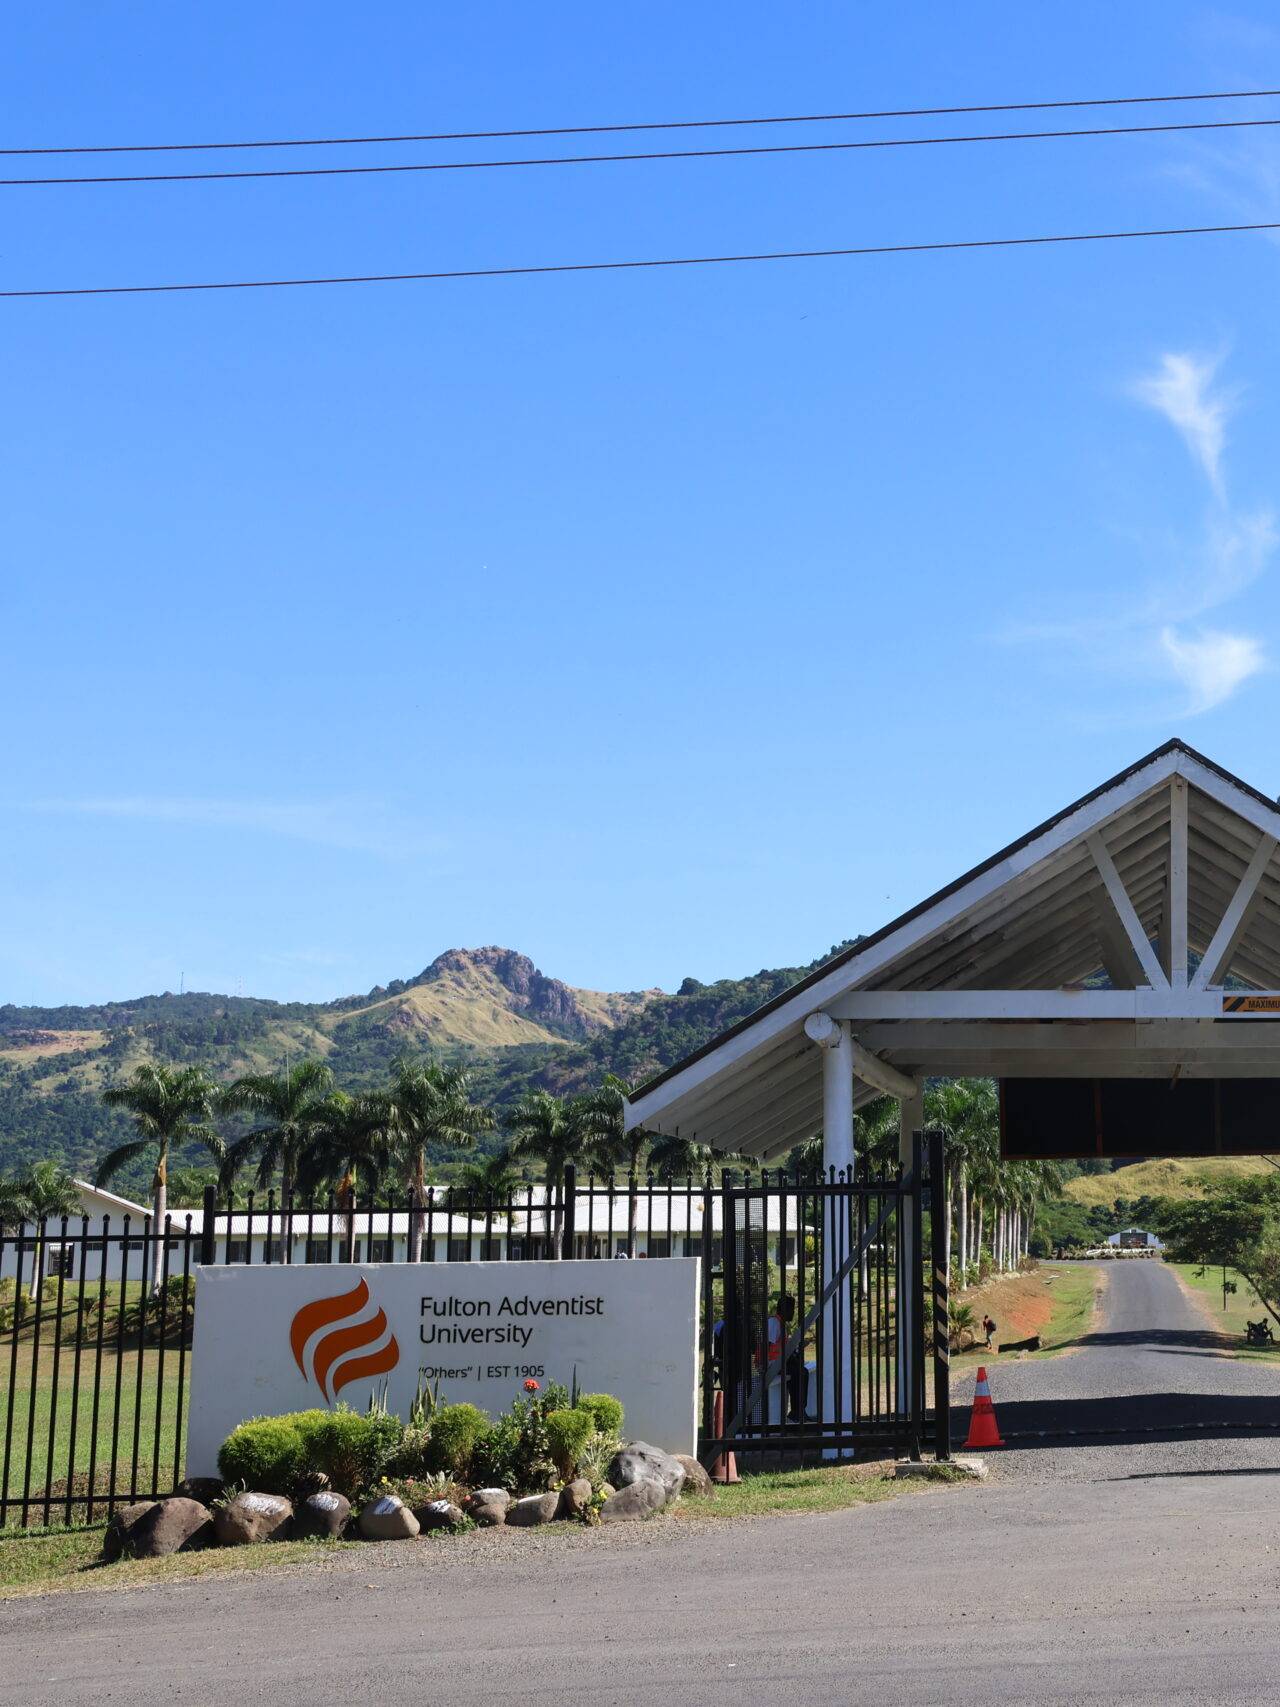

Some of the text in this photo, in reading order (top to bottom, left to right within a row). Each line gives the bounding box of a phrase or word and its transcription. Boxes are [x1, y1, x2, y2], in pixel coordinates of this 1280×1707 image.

[420, 1295, 604, 1317] Fulton Adventist
[419, 1323, 533, 1348] University
[418, 1366, 473, 1379] “Others”
[487, 1366, 510, 1378] EST
[513, 1365, 545, 1378] 1905
